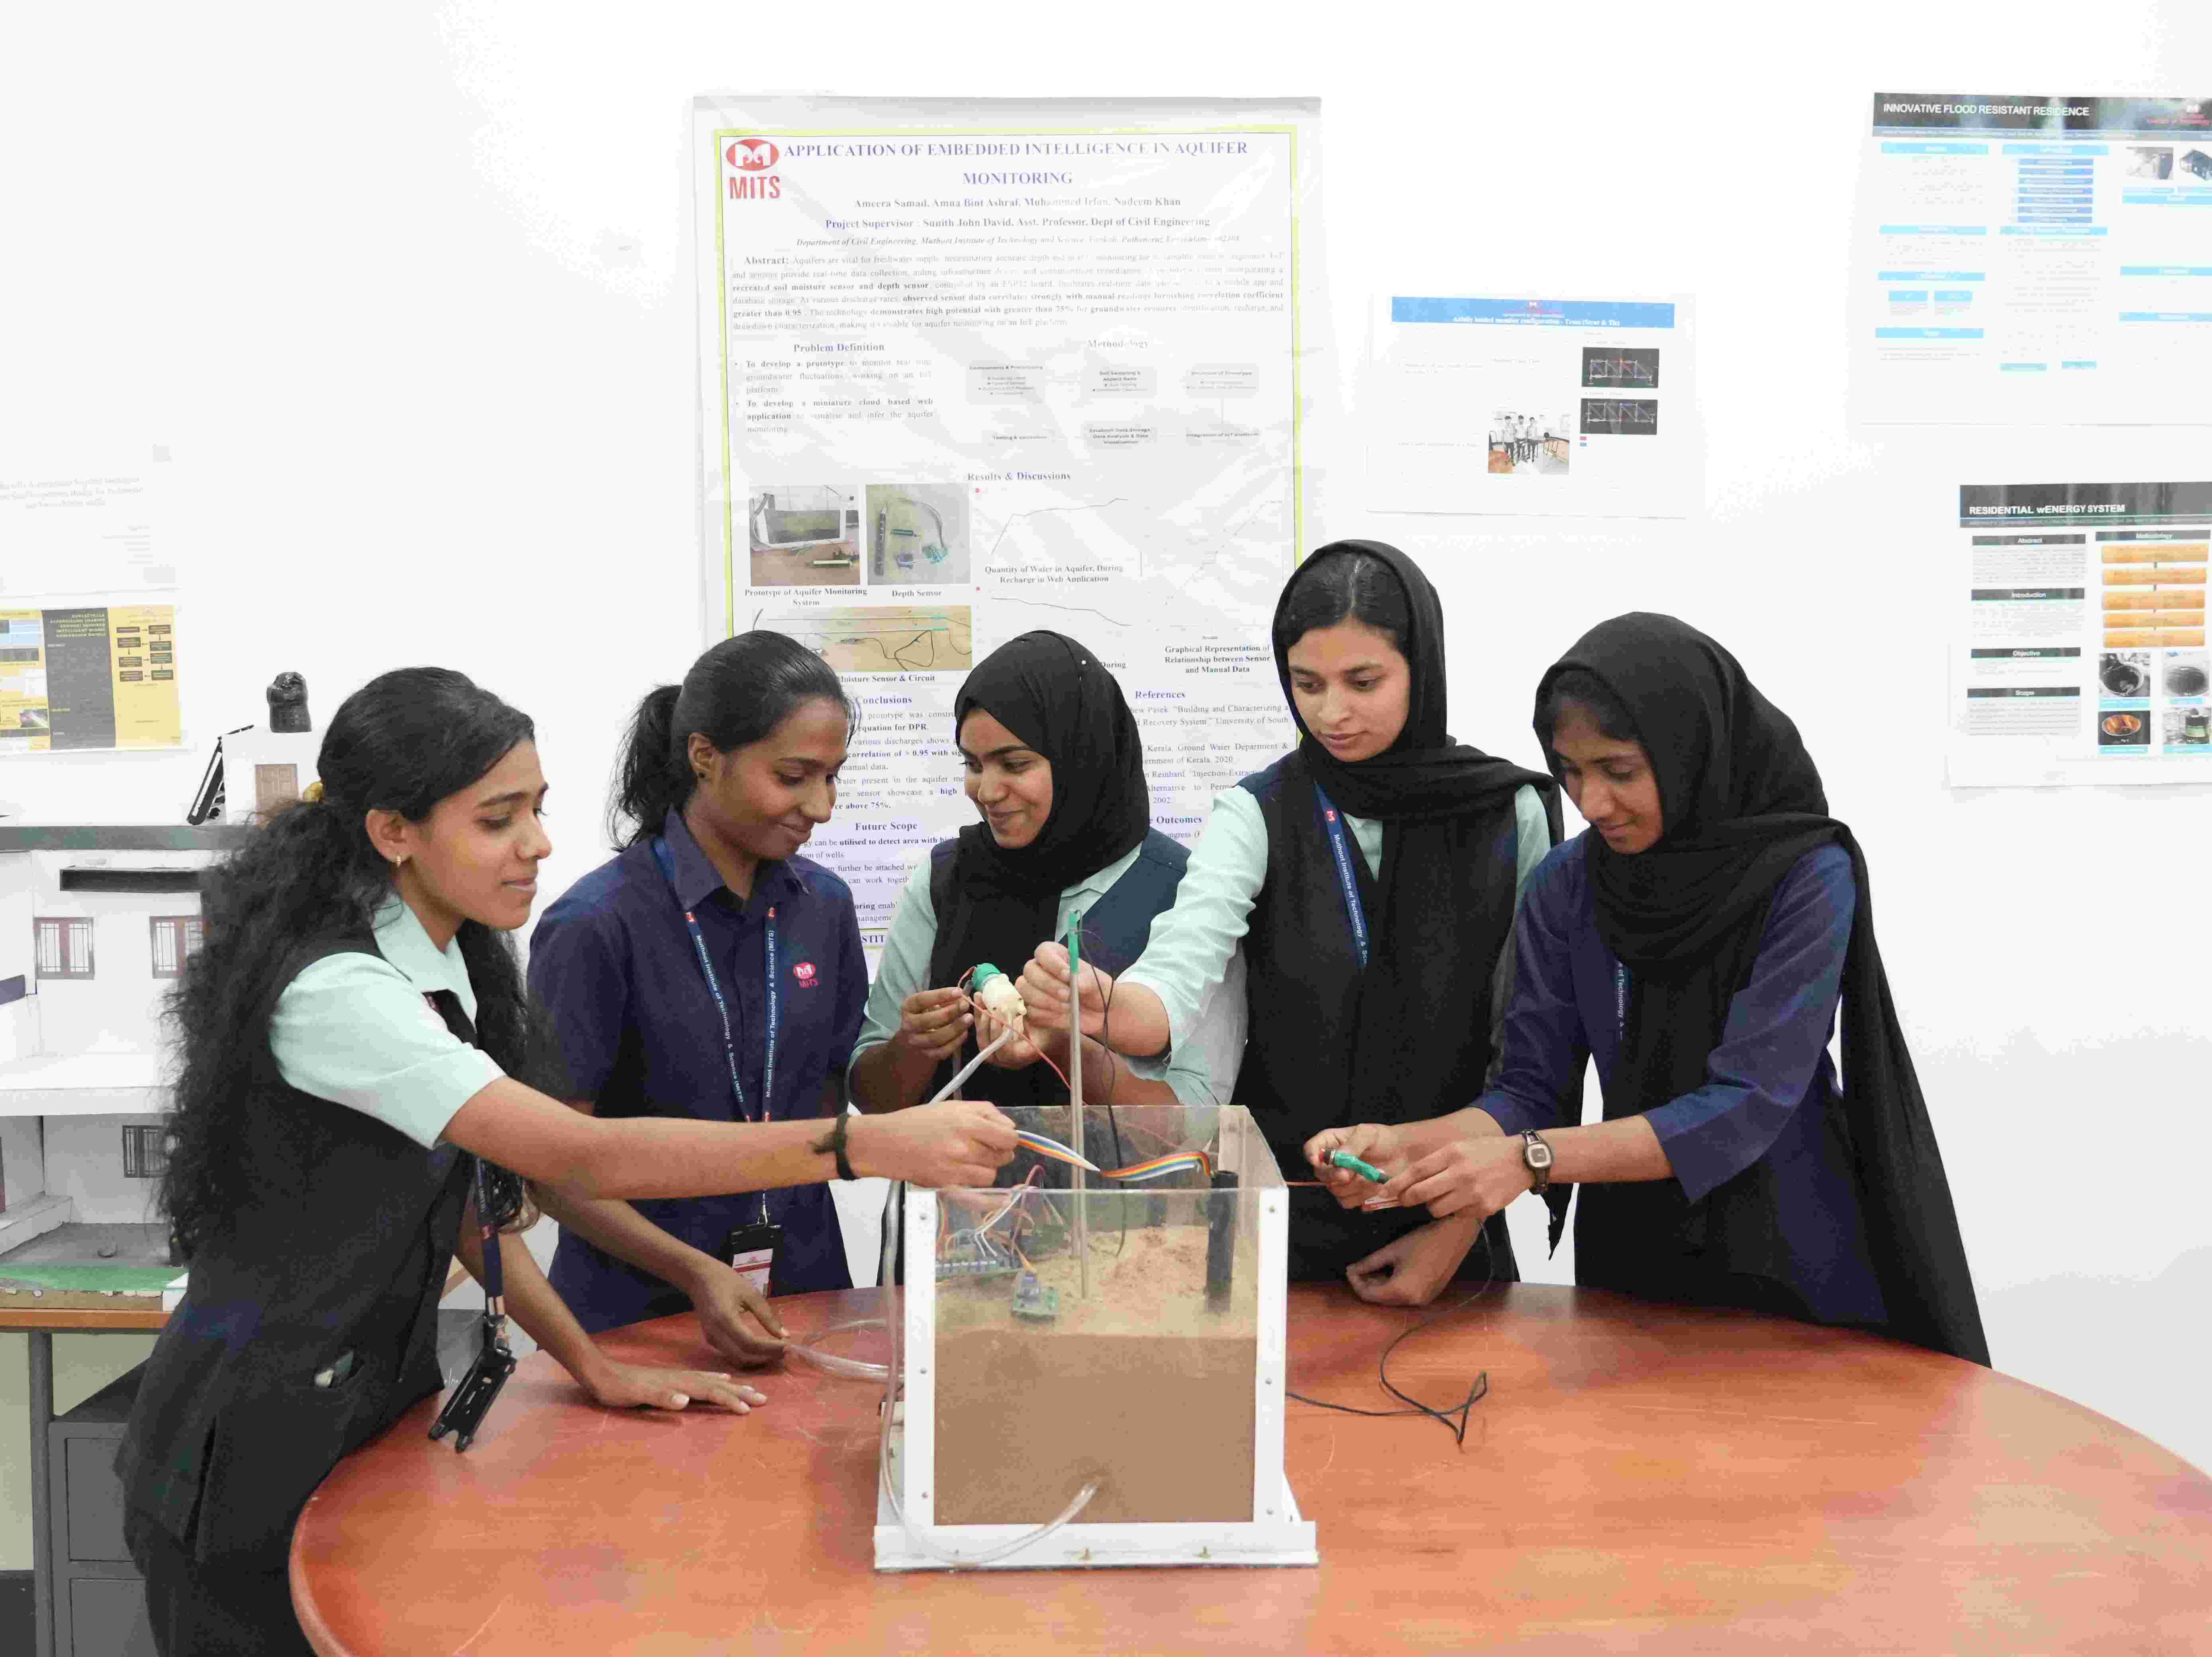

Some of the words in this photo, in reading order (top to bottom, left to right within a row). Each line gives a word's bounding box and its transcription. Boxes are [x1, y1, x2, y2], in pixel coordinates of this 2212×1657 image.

[1884, 103, 1941, 114] INNOVATIVE
[1943, 104, 1977, 114] FLOOD
[1979, 104, 2032, 115] RESISTANT
[2034, 106, 2089, 116] RESIDENCE
[784, 145, 895, 157] APPLICATION
[902, 144, 923, 156] OF
[928, 144, 1020, 156] EMBEDDED
[1026, 143, 1147, 155] INTELLIGENCE
[1154, 142, 1169, 153] IN
[1175, 141, 1247, 155] AQUIFER
[963, 172, 1072, 184] MONITORING
[730, 176, 780, 199] MITS
[855, 199, 891, 208] Ameera
[933, 199, 960, 208] Amna
[1115, 198, 1151, 206] Nadeem
[1155, 198, 1181, 206] Khan
[825, 219, 859, 230] Project
[862, 219, 913, 229] Supervisor
[957, 217, 980, 227] John
[1091, 217, 1112, 228] Dept
[1116, 217, 1126, 226] of
[1128, 217, 1150, 226] Civil
[745, 256, 789, 264] Abstract:
[878, 282, 899, 291] depth
[926, 306, 943, 315] high
[794, 344, 833, 353] Problem
[837, 343, 886, 352] Definition
[747, 412, 791, 421] application
[968, 472, 1001, 481] Results
[1005, 471, 1013, 480] &
[1017, 471, 1071, 480] Discussions
[1970, 506, 2033, 515] RESIDENTIAL
[2088, 504, 2125, 513] SYSTEM
[985, 566, 1017, 575] Quantity
[1097, 564, 1123, 574] During
[1000, 575, 1035, 585] Recharge
[1066, 574, 1109, 584] Application
[745, 589, 781, 598] Prototype
[793, 588, 822, 597] Aquifer
[825, 587, 867, 596] Monitoring
[892, 589, 914, 598] Depth
[1165, 645, 1202, 655] Graphical
[1205, 644, 1260, 654] Representation
[1165, 655, 1211, 664] Relationship
[1143, 719, 1177, 727] Recovery
[1235, 743, 1277, 752] Department
[940, 787, 957, 797] high
[1157, 815, 1202, 824] Outcomes
[855, 822, 887, 831] Future
[890, 822, 918, 832] Scope
[1334, 834, 1345, 862] Muthoot
[1341, 862, 1352, 890] Institute
[1351, 899, 1363, 937] Technology
[697, 935, 708, 962] Muthoot
[705, 964, 718, 991] Institute
[719, 1000, 731, 1040] Technology
[729, 1052, 737, 1079] Science
